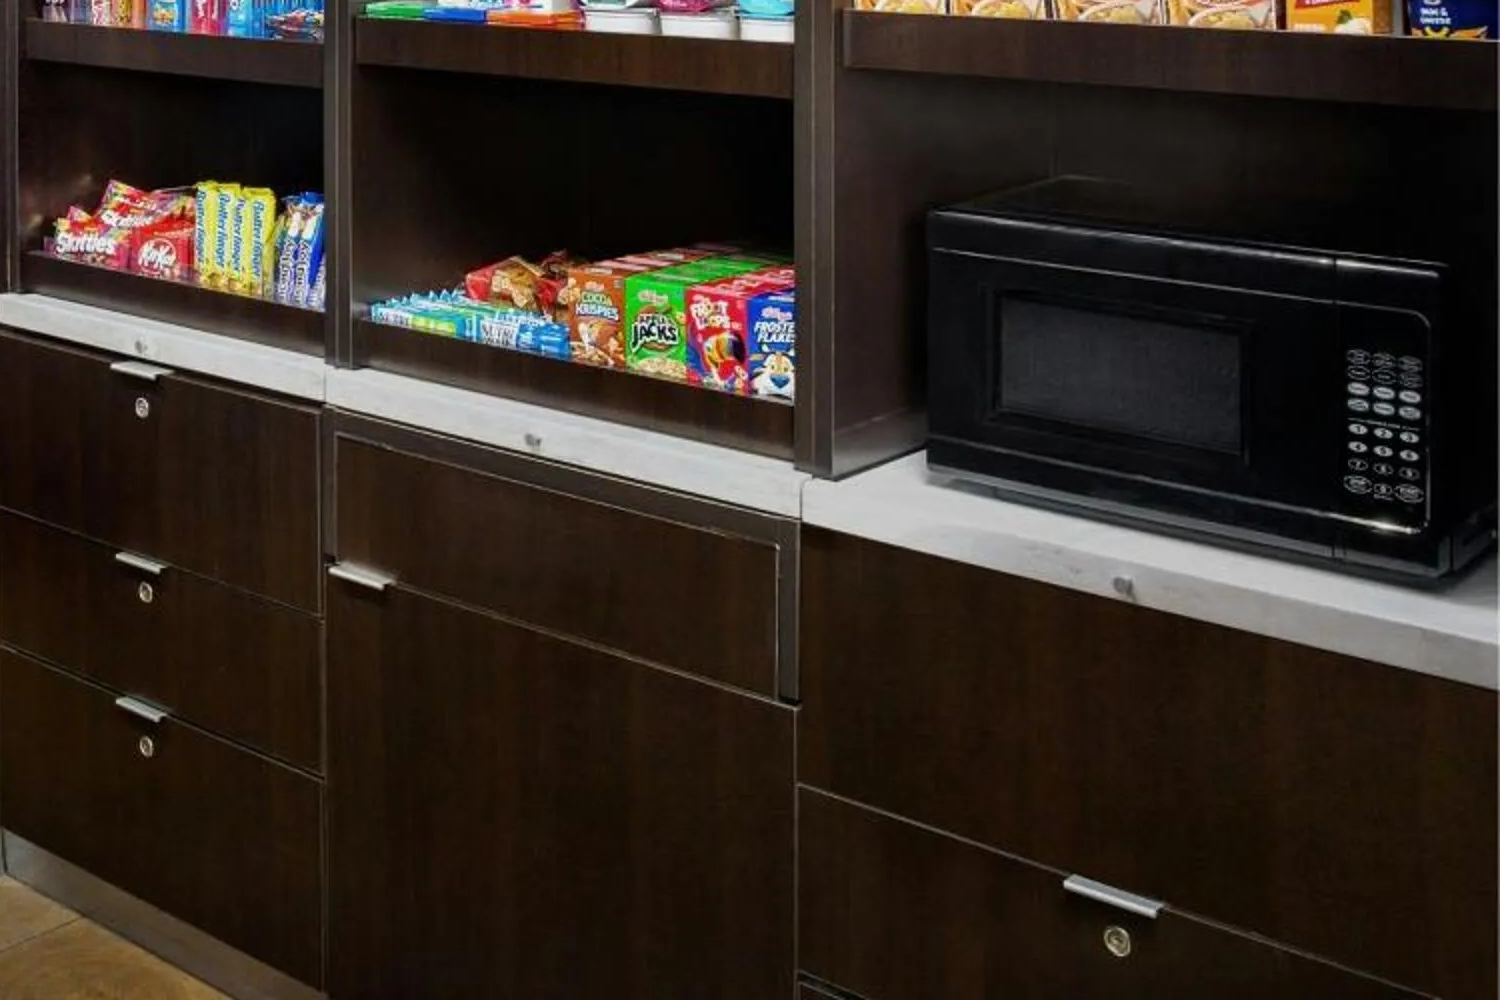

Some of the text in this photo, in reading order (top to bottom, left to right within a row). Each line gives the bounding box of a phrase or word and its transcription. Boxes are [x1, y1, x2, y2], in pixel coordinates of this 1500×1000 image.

[56, 231, 116, 256] Skittles
[631, 322, 678, 352] JACKS
[754, 321, 795, 334] FROSTE
